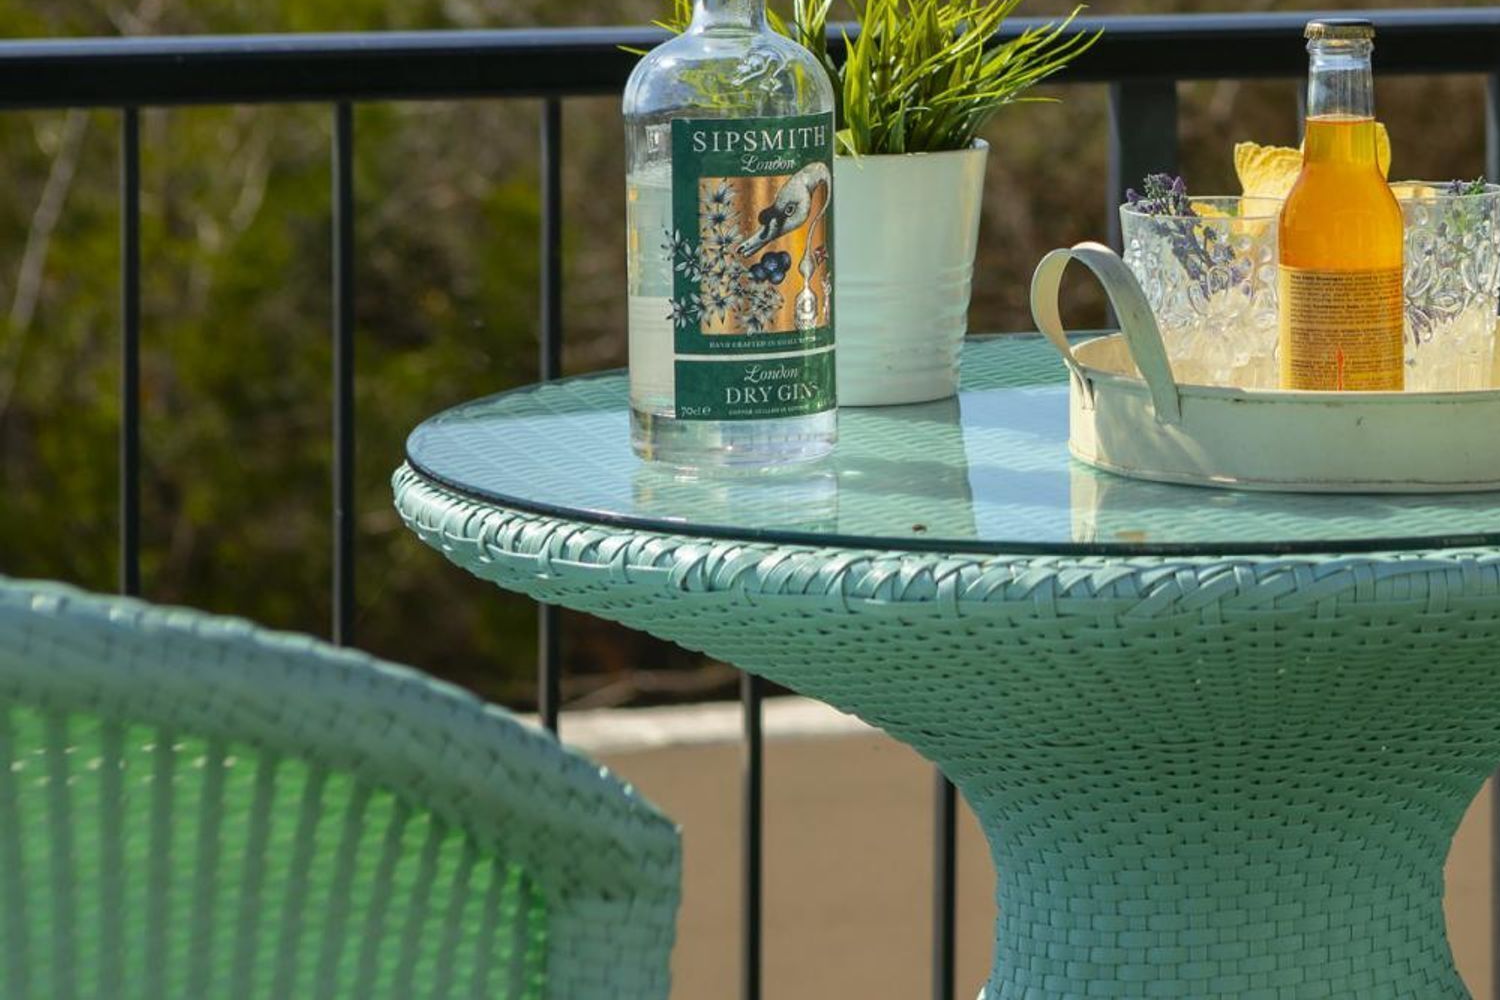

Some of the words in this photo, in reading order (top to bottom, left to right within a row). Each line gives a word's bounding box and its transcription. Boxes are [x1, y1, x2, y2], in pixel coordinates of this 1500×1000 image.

[692, 126, 825, 152] SIPSMITH
[741, 154, 796, 173] London
[743, 364, 799, 383] London
[726, 386, 773, 405] DRY
[777, 381, 818, 401] GIN
